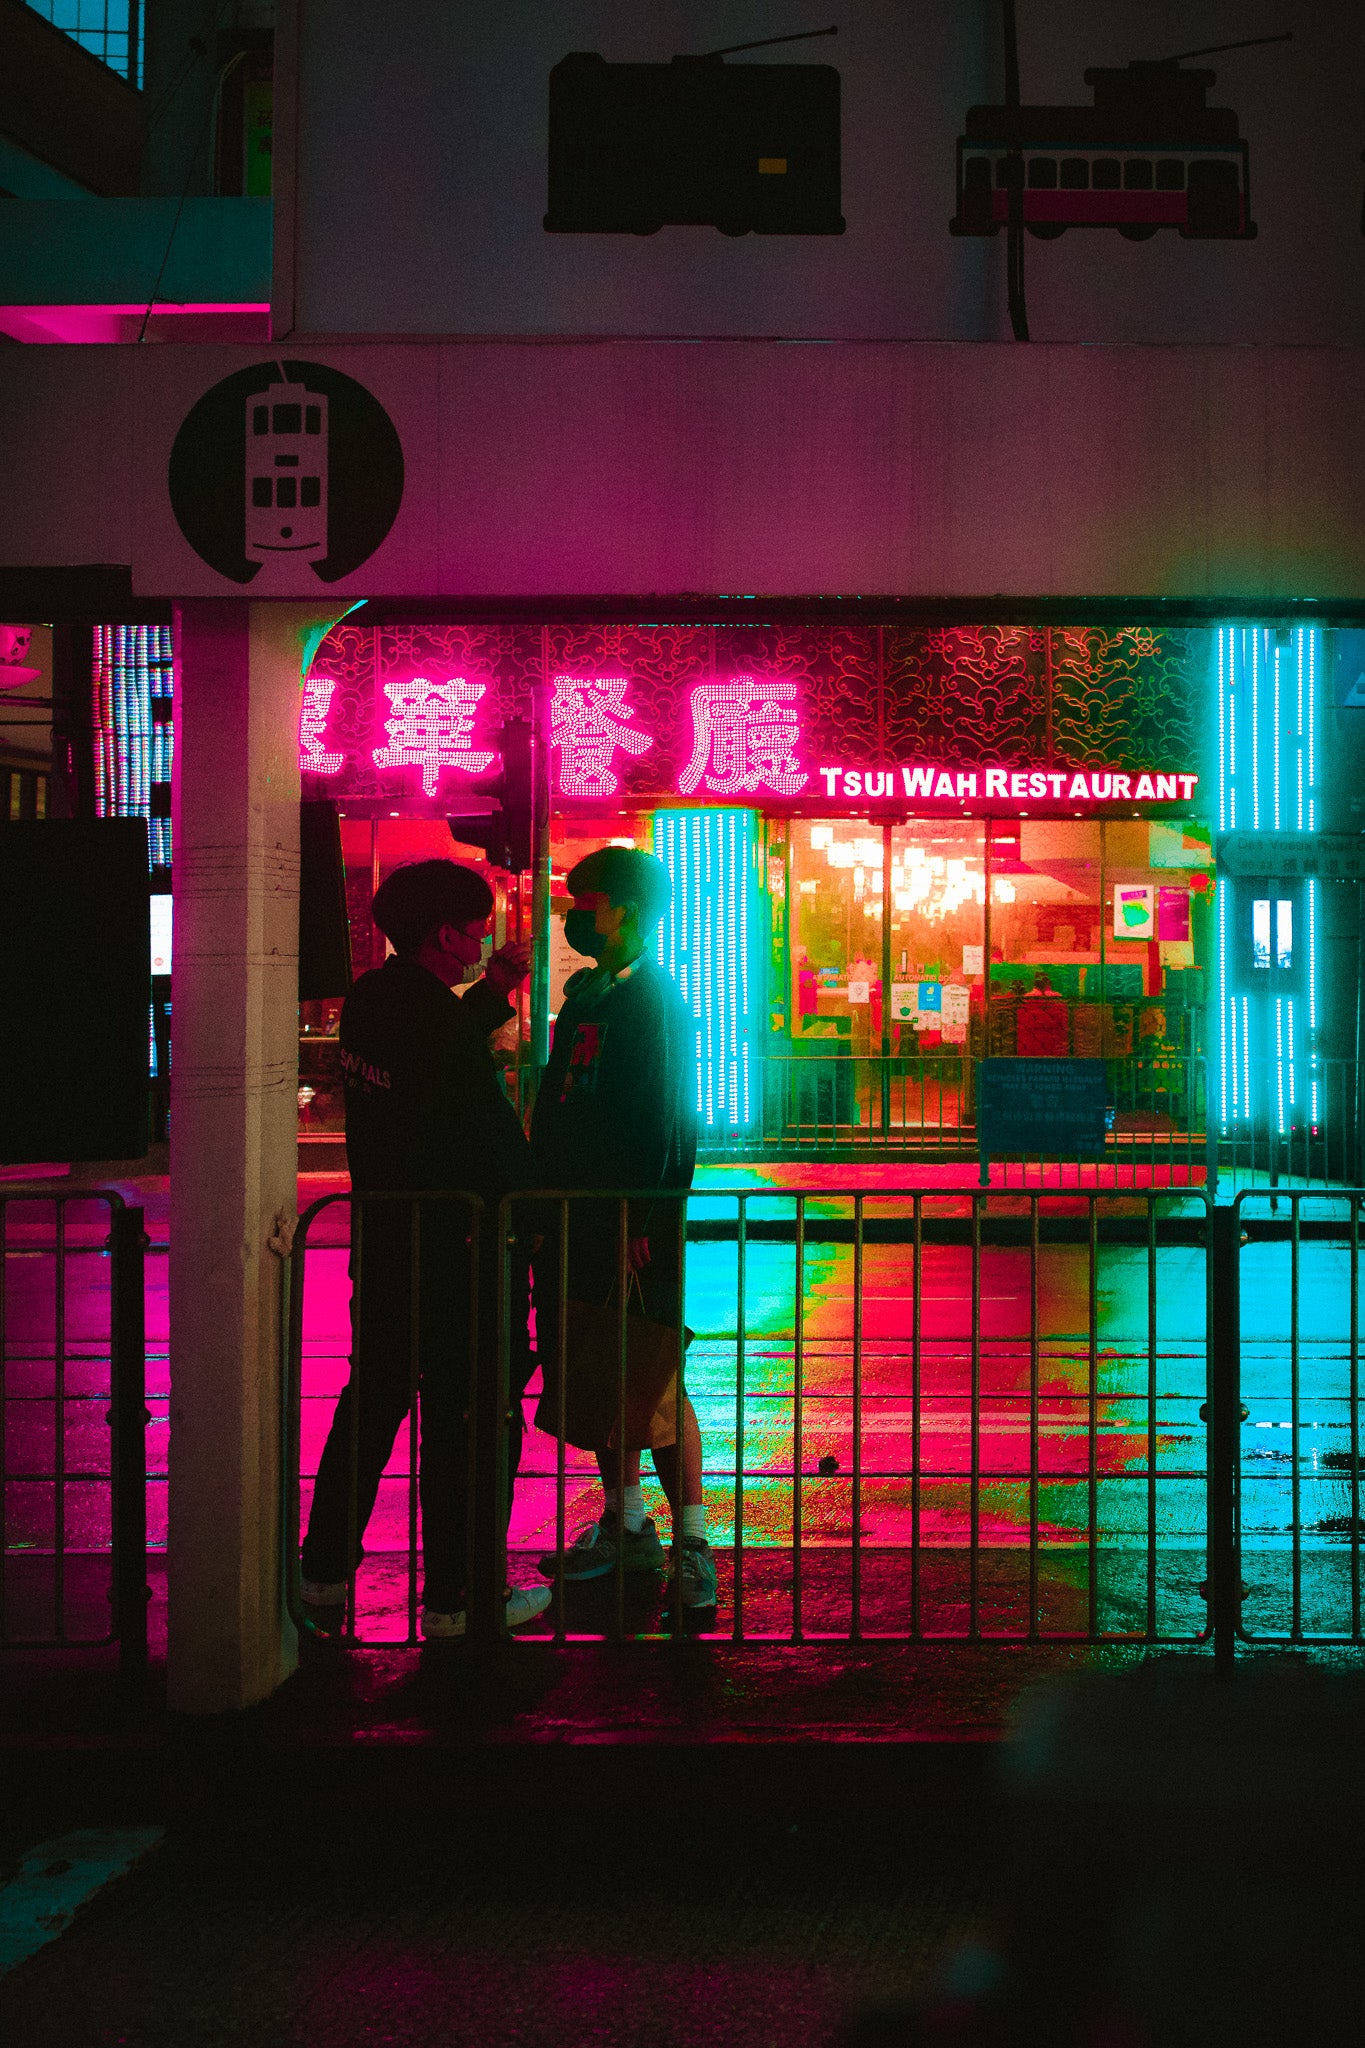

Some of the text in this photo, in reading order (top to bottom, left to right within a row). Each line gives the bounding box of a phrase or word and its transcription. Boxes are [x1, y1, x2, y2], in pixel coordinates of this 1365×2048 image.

[819, 767, 1199, 800] TSUI WAH RESTAURANT
